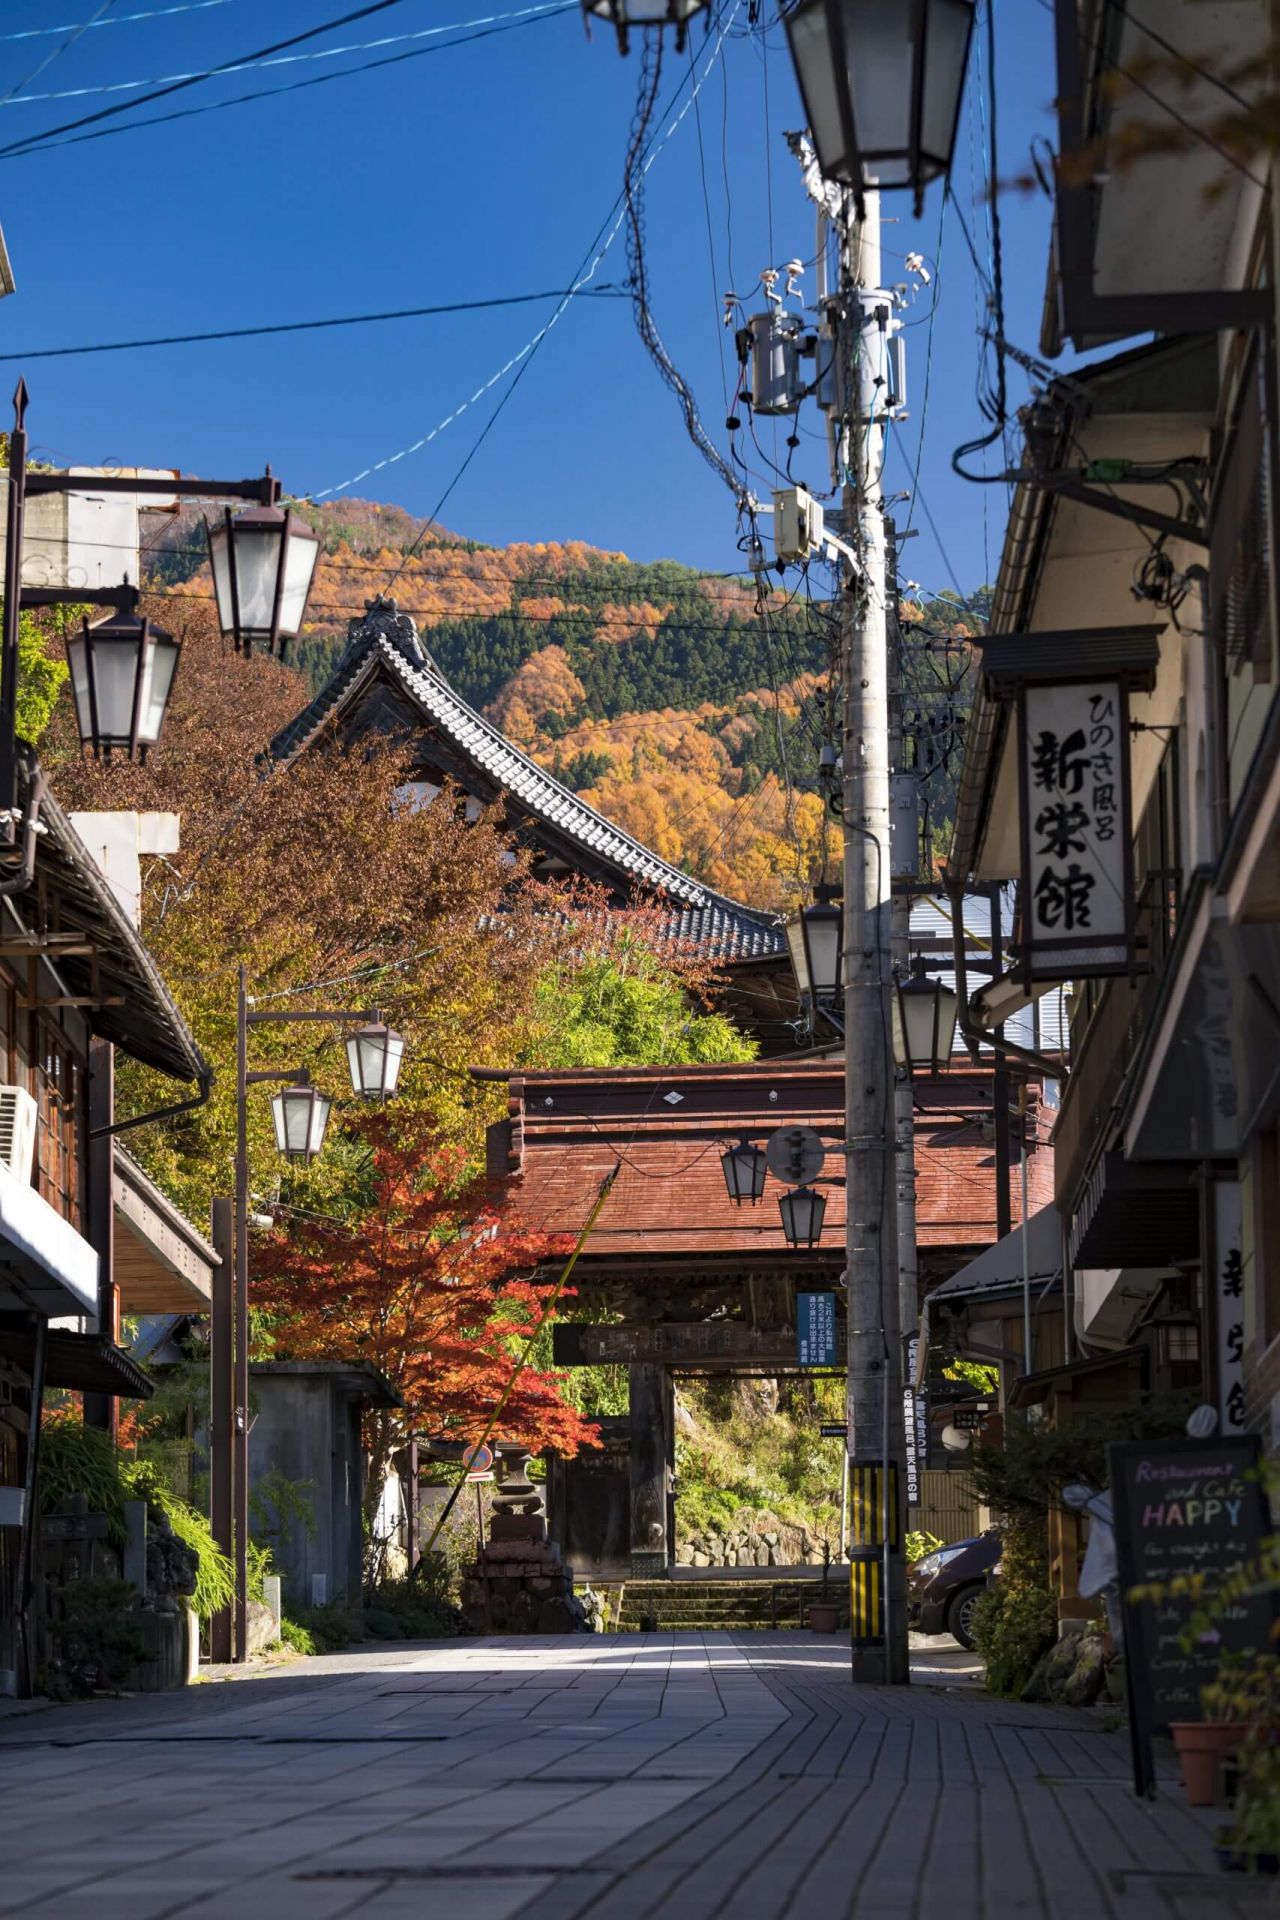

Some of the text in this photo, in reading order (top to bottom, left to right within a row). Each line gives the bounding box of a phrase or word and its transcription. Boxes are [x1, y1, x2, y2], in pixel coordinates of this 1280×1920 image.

[1031, 728, 1096, 931] 新栄館
[1087, 693, 1117, 843] ひのき風呂
[1141, 1498, 1242, 1528] HAPPY
